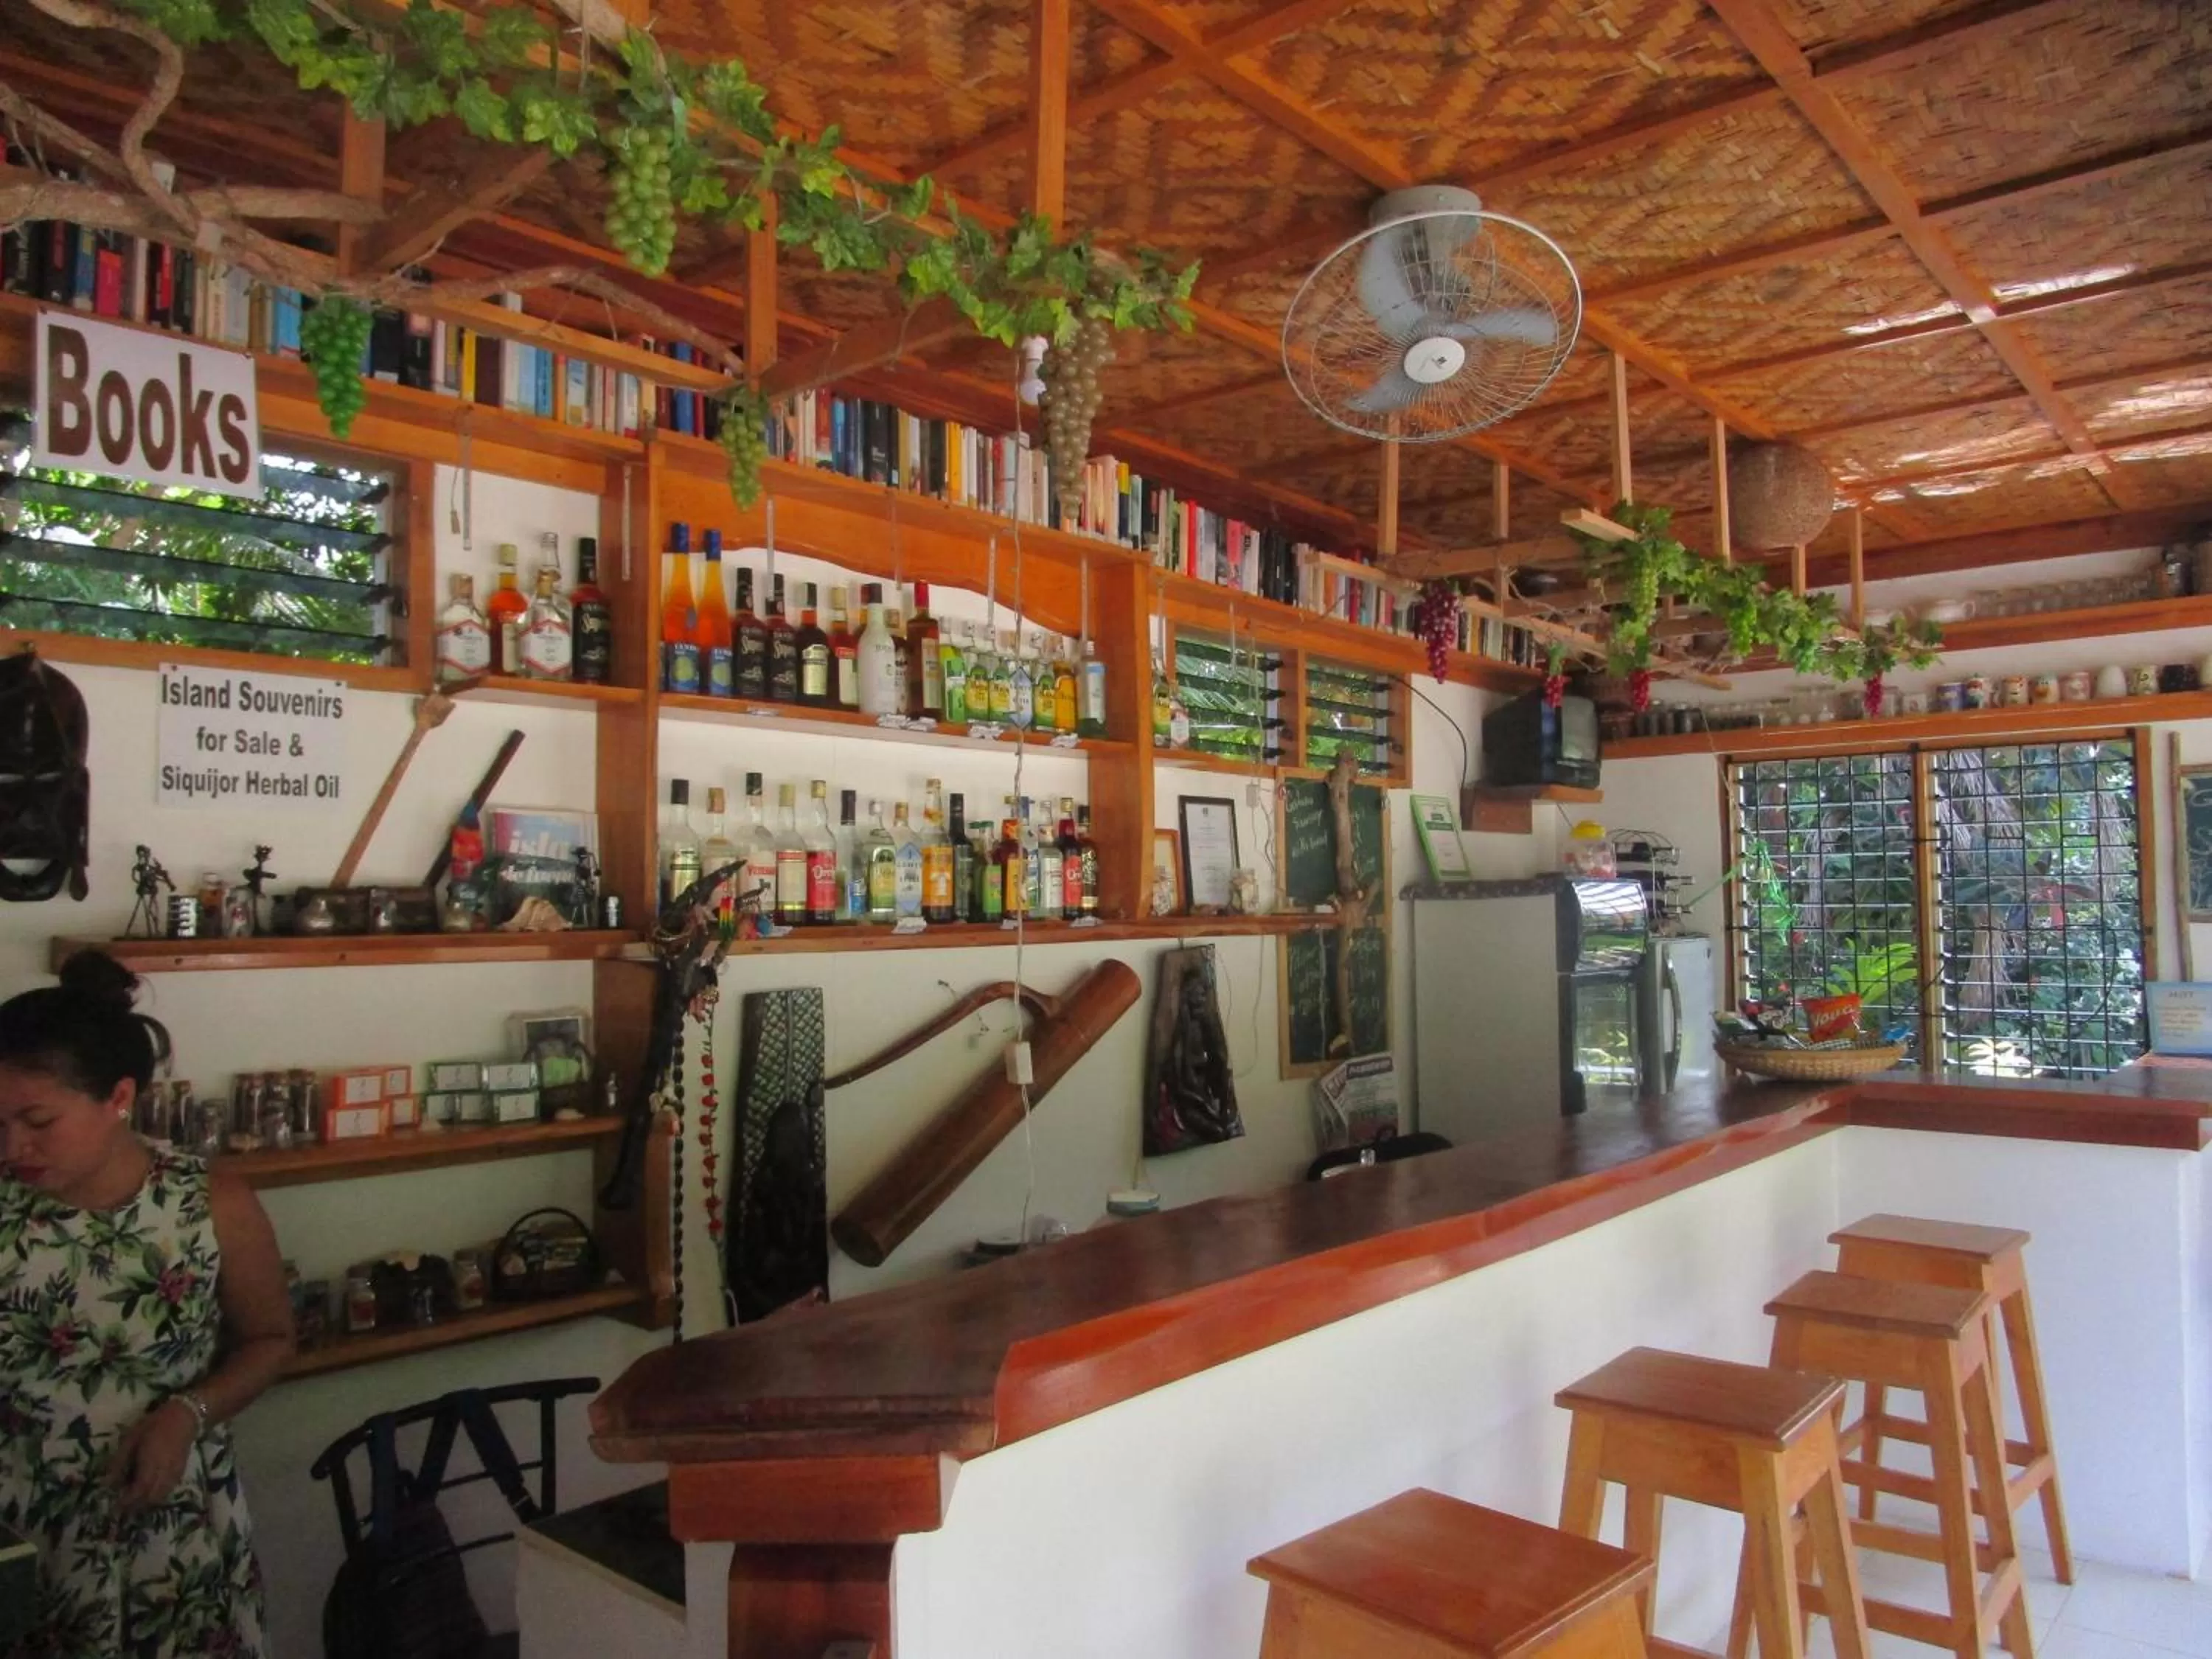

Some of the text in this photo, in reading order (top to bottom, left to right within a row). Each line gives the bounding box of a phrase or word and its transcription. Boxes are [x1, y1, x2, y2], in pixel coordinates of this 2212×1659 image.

[47, 324, 250, 484] Books
[161, 675, 343, 720] Island Souvenirs
[196, 726, 304, 756] for Sale &
[161, 765, 339, 799] Siquijor Herbal Oil
